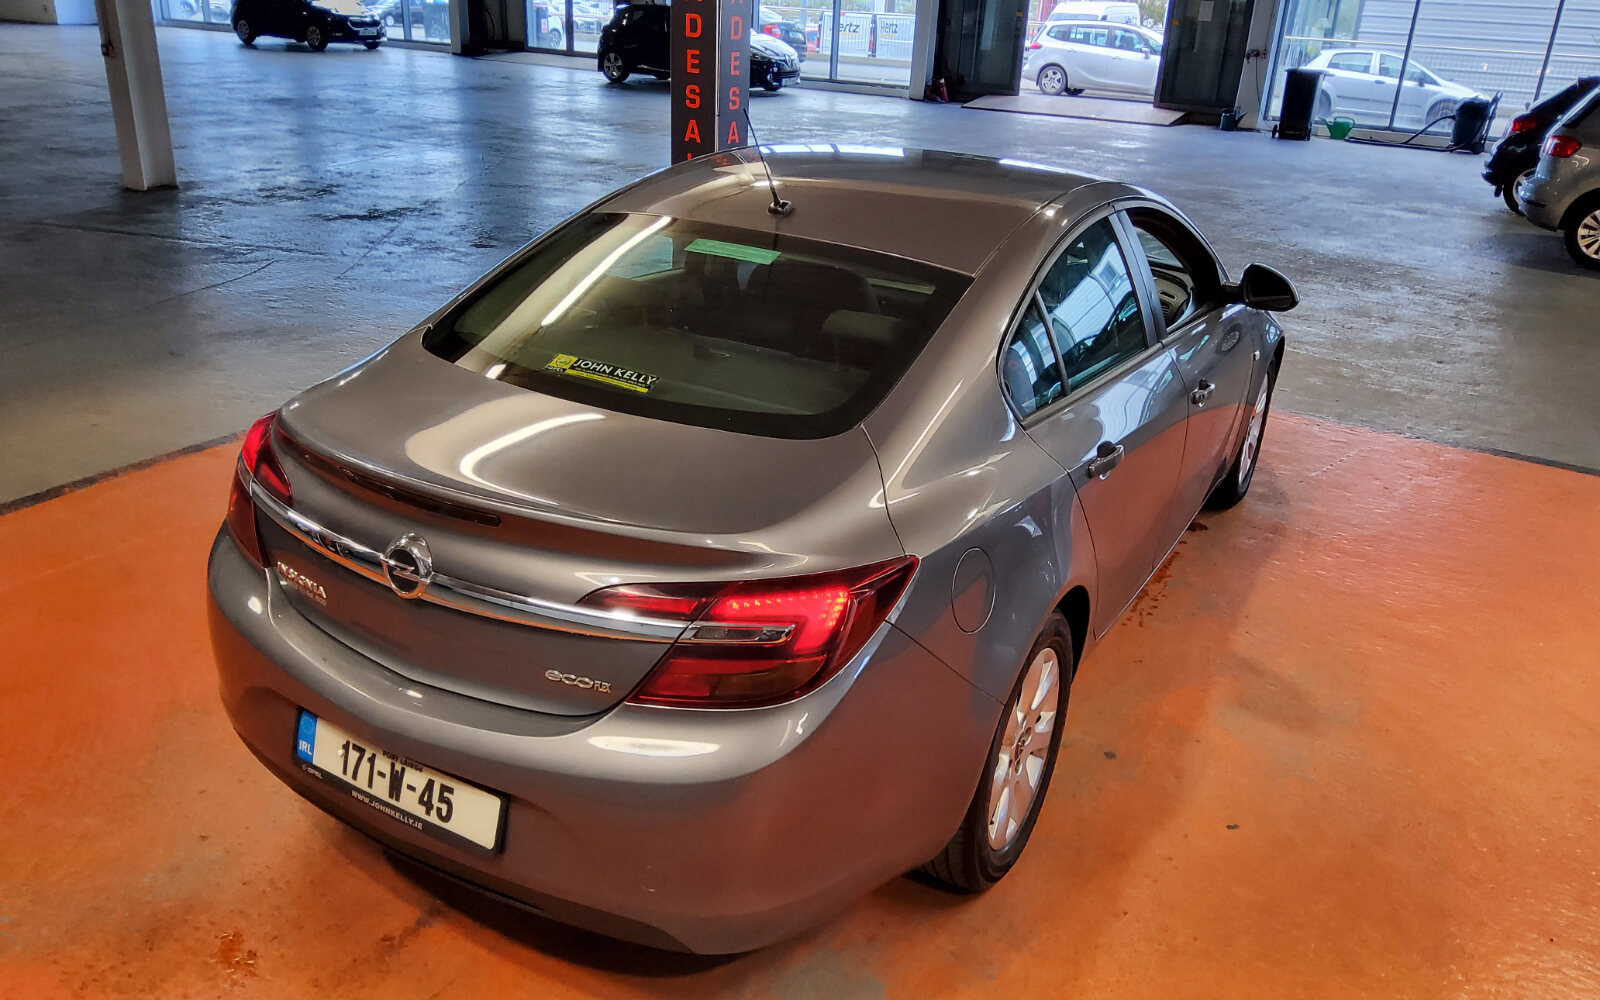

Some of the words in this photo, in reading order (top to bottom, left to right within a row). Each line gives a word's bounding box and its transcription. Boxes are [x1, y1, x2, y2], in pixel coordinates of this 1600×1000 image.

[881, 21, 898, 34] Hertz
[684, 0, 702, 160] DESA
[574, 359, 614, 374] JOHN
[614, 368, 658, 385] KELLY
[299, 740, 313, 756] IRL
[341, 740, 455, 824] 171-W-45
[351, 790, 423, 831] WWW.JOHNKELLY.IE
